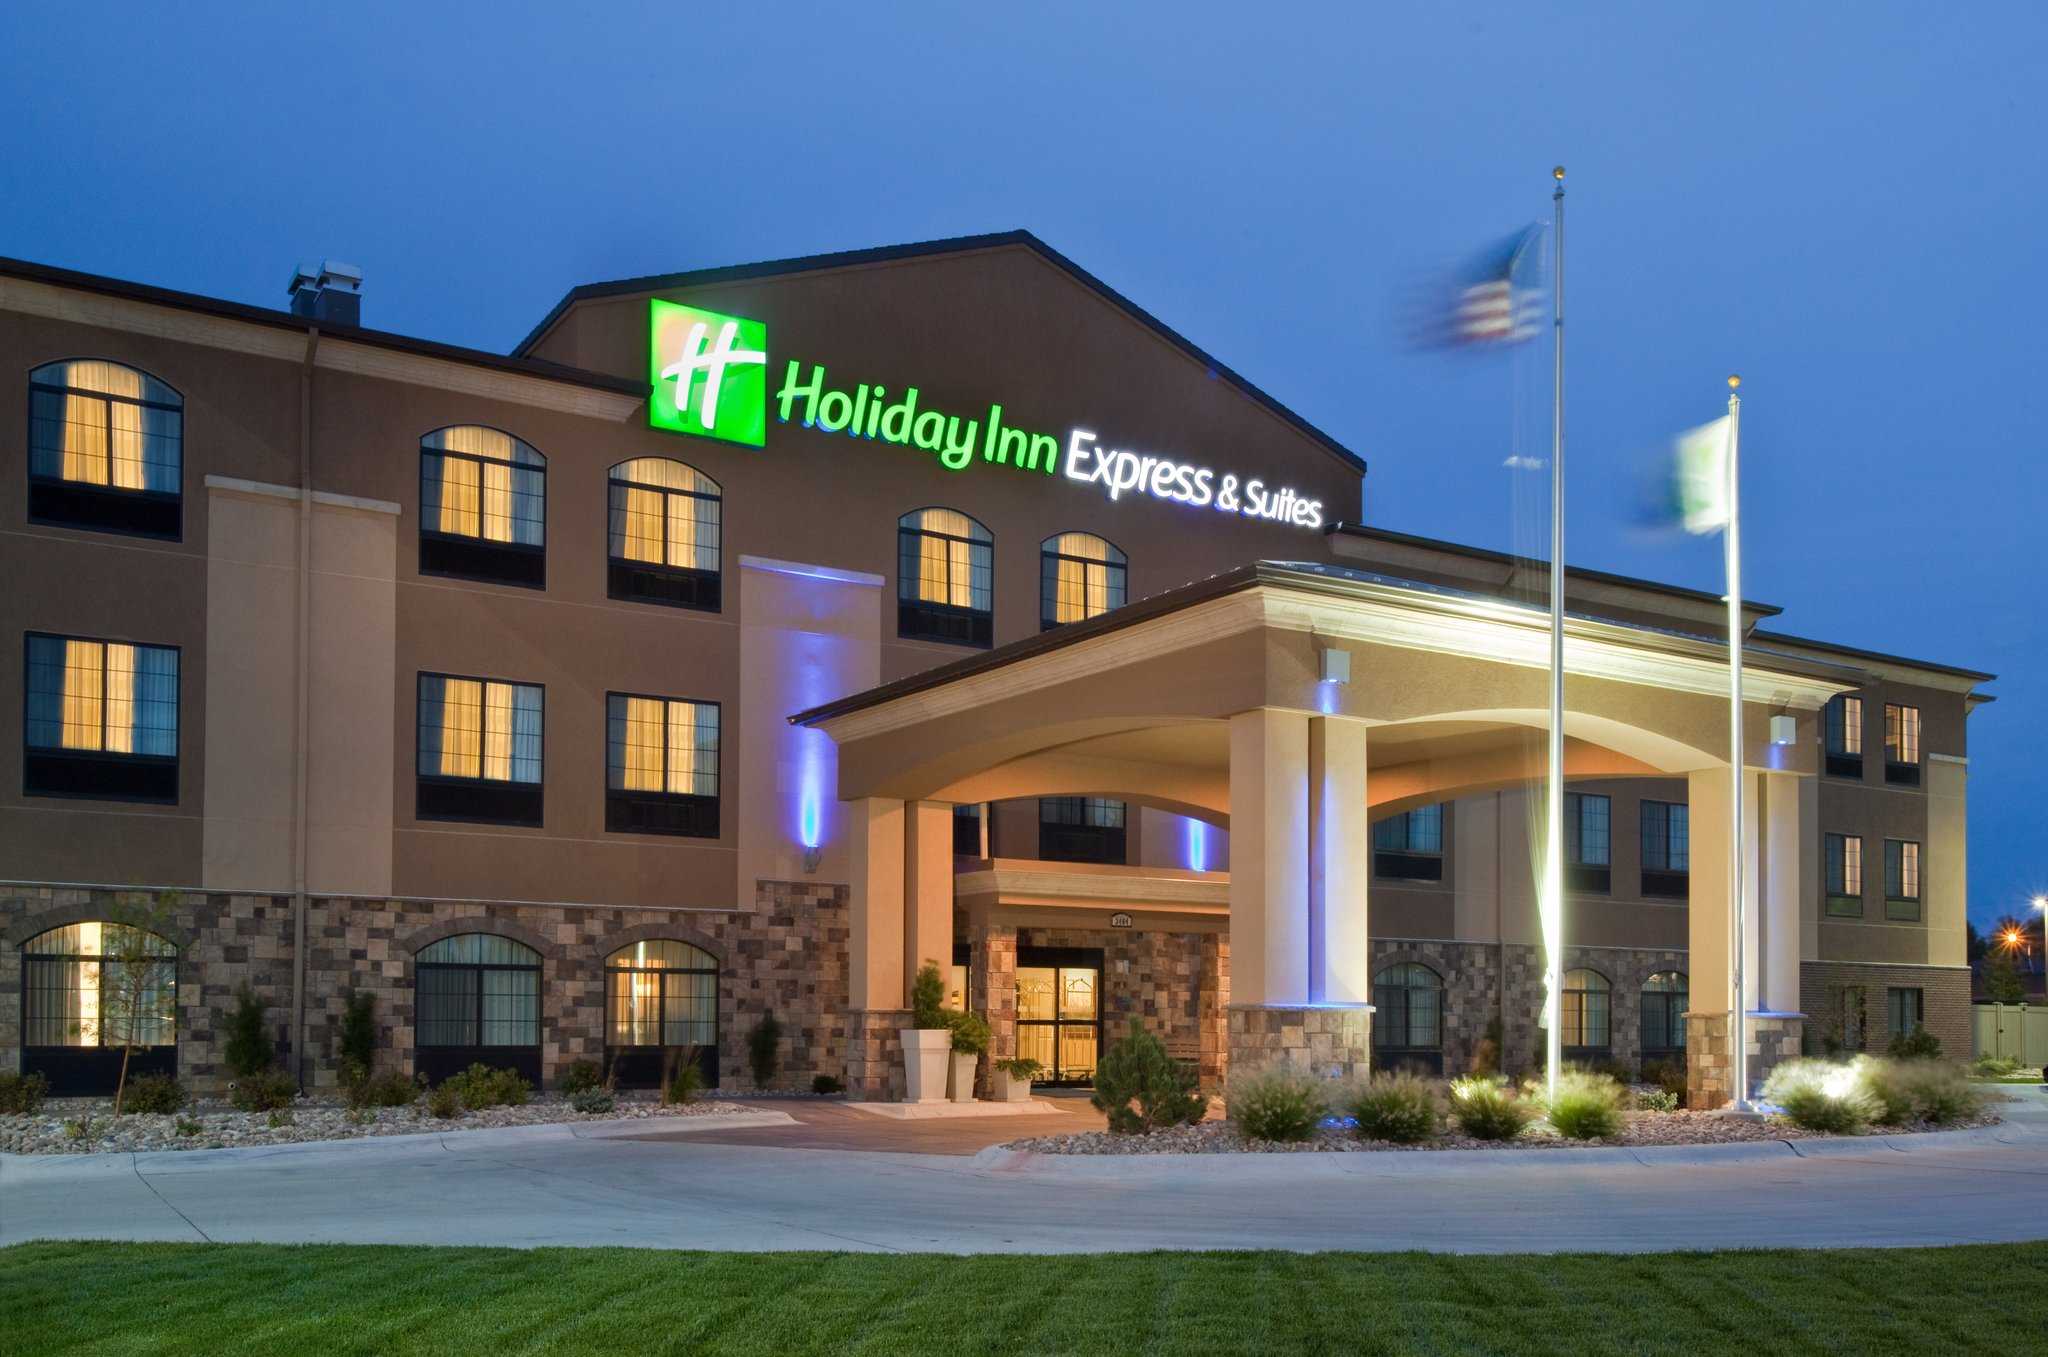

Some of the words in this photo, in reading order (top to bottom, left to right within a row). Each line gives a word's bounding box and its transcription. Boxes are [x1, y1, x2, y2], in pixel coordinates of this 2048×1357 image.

[776, 360, 979, 470] Holiday
[984, 404, 1058, 474] Inn
[1064, 429, 1214, 506] Express
[1218, 474, 1240, 512] &
[1243, 480, 1323, 528] Suites
